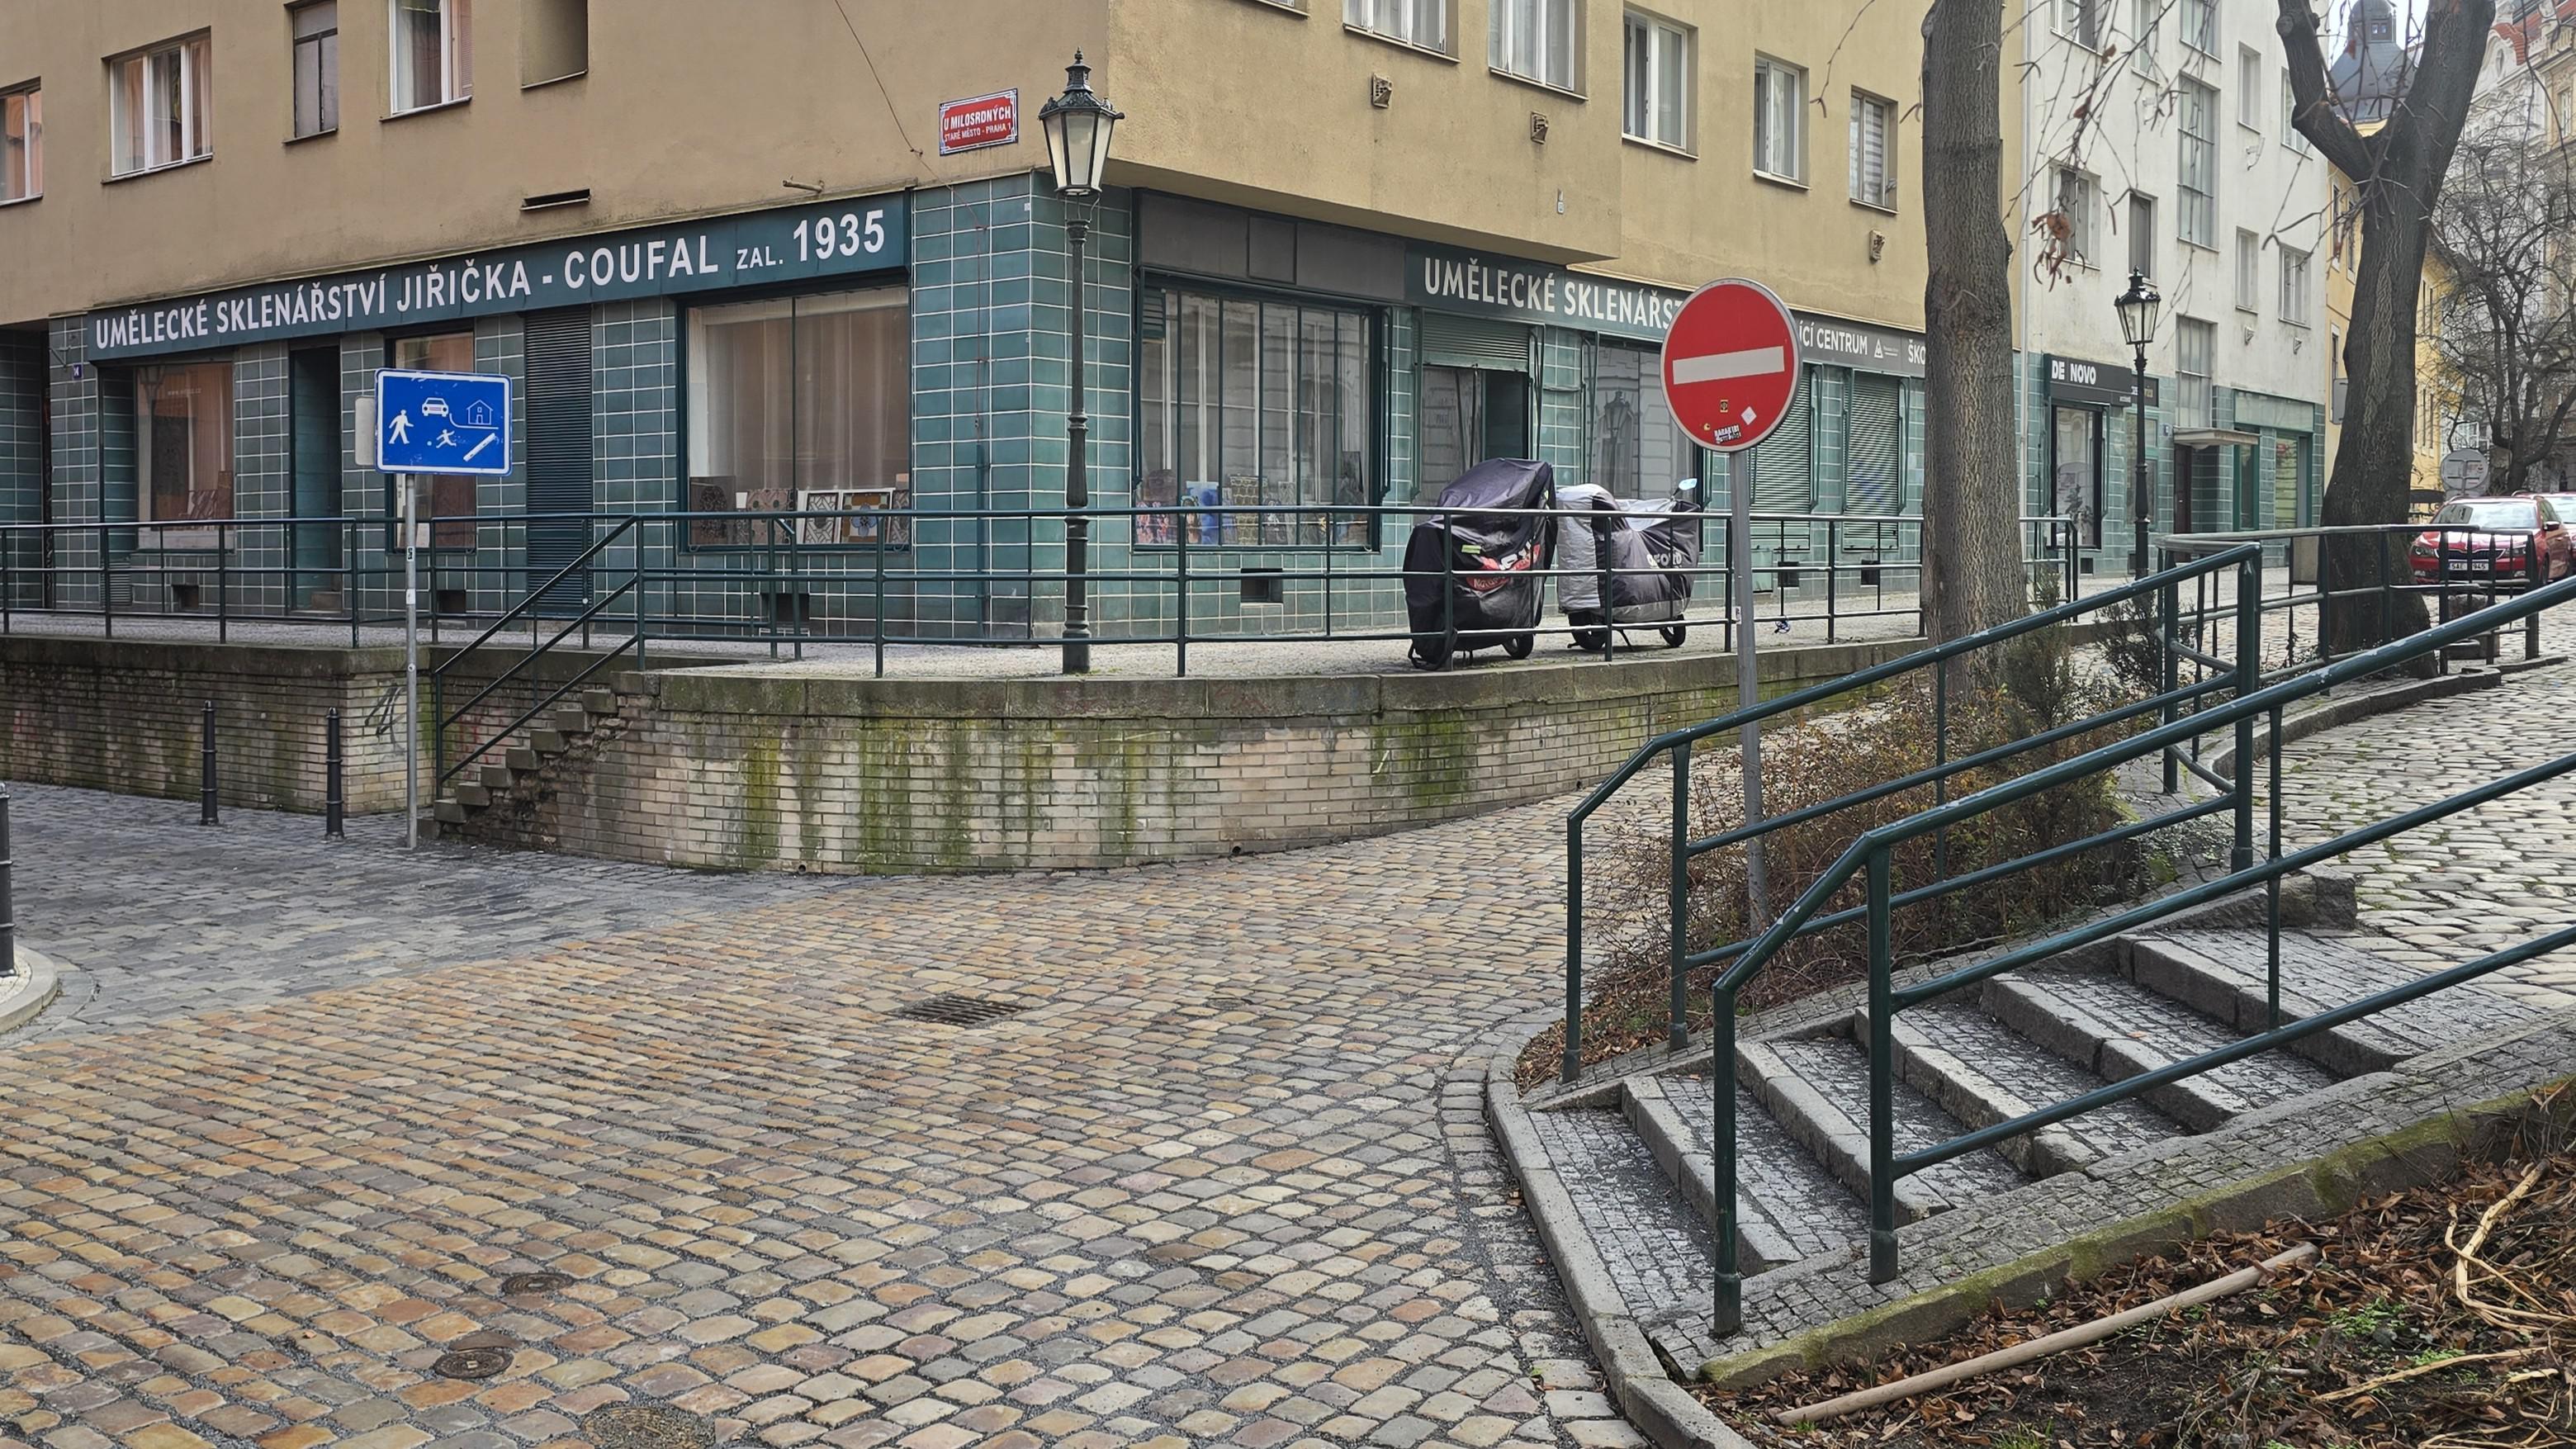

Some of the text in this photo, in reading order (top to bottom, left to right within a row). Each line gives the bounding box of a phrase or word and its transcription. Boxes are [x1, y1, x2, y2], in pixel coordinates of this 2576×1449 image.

[944, 104, 1011, 130] U MILOSRDNÝCH
[945, 130, 961, 142] STARÉ
[962, 128, 981, 139] MĚSTO
[986, 123, 1006, 135] PRAHA
[96, 210, 885, 349] UMĚLECKÉ SKLENÁŘSTVÍ JIŘIČKA - COUFAL ZAL. 1935
[1424, 257, 1683, 330] UMĚLECKÉ SKLENÁŘS
[1798, 320, 1868, 356] ÍCÍ CENTRUM
[1908, 339, 1926, 365] ŠKO
[2051, 360, 2097, 385] DE NOVO
